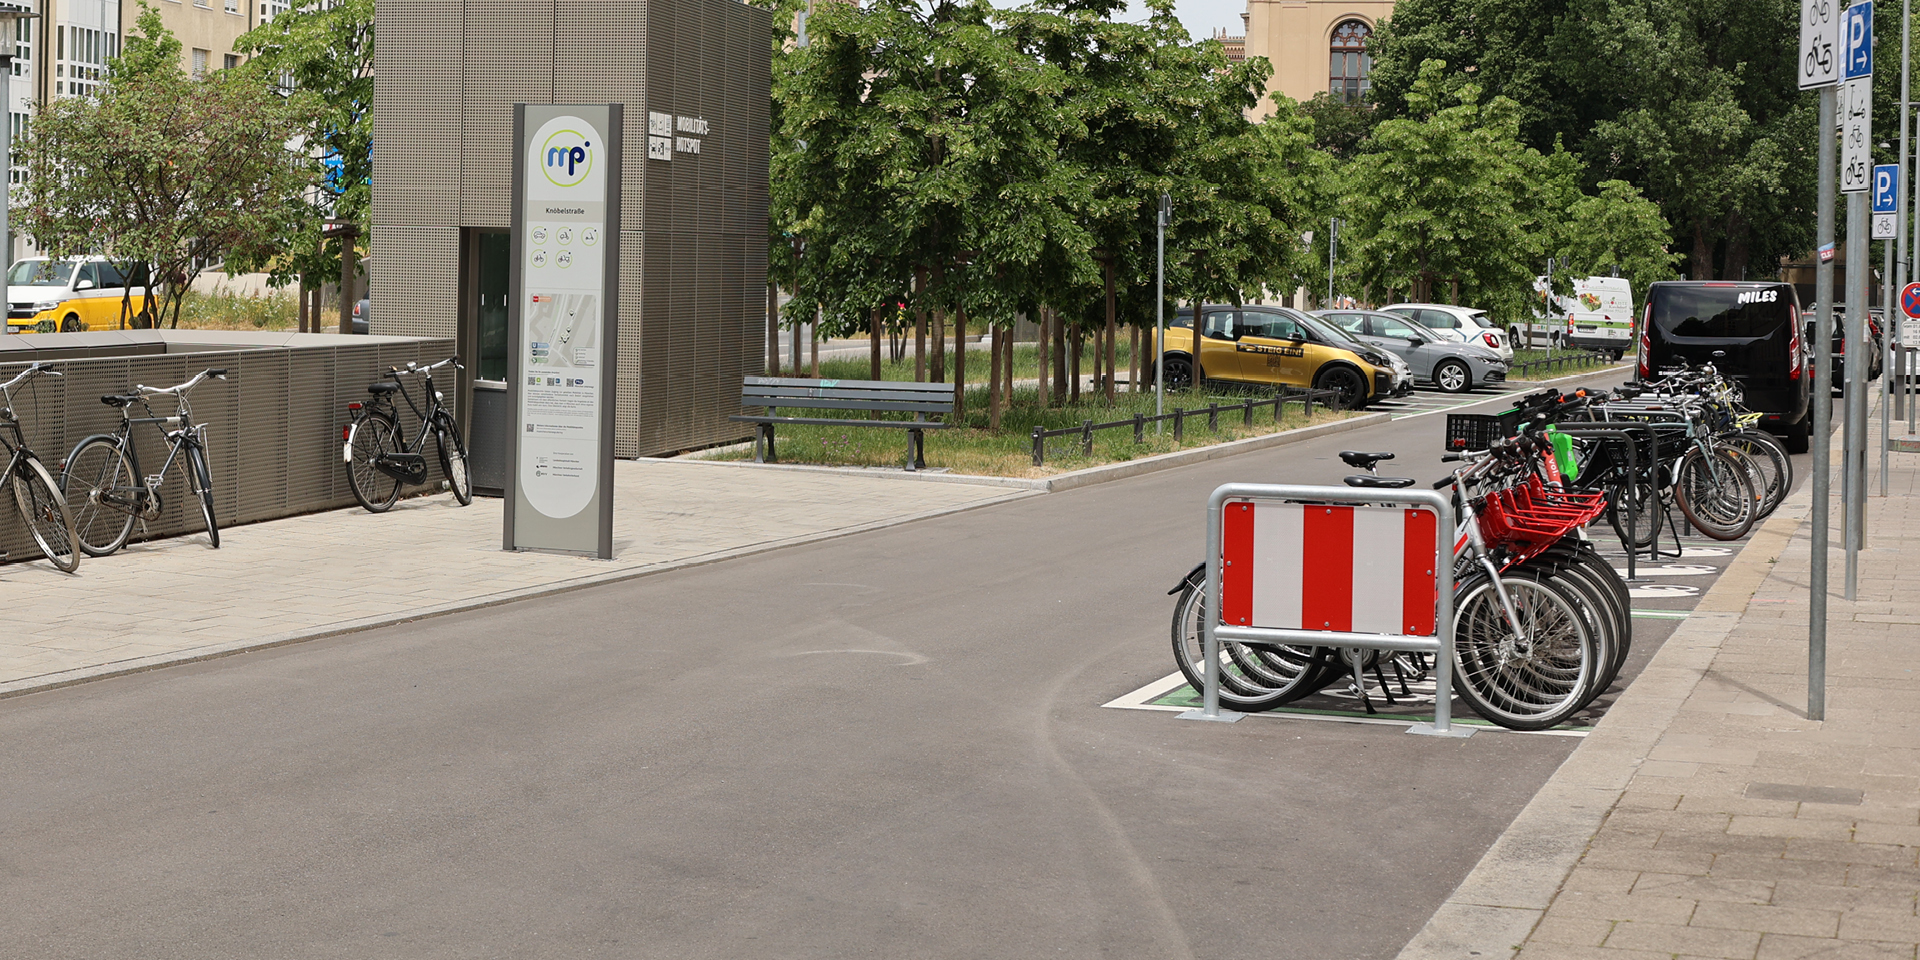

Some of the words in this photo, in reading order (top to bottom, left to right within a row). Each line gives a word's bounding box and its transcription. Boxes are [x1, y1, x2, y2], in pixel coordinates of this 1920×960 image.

[1850, 14, 1865, 71] P
[677, 115, 710, 135] MOBILITÄTS-
[676, 136, 701, 154] HOTSPOT
[1876, 171, 1891, 206] P
[545, 207, 585, 215] Knöbelstraße
[1737, 290, 1778, 304] MILES
[1257, 345, 1282, 354] STEIG
[1284, 347, 1301, 356] EIN!
